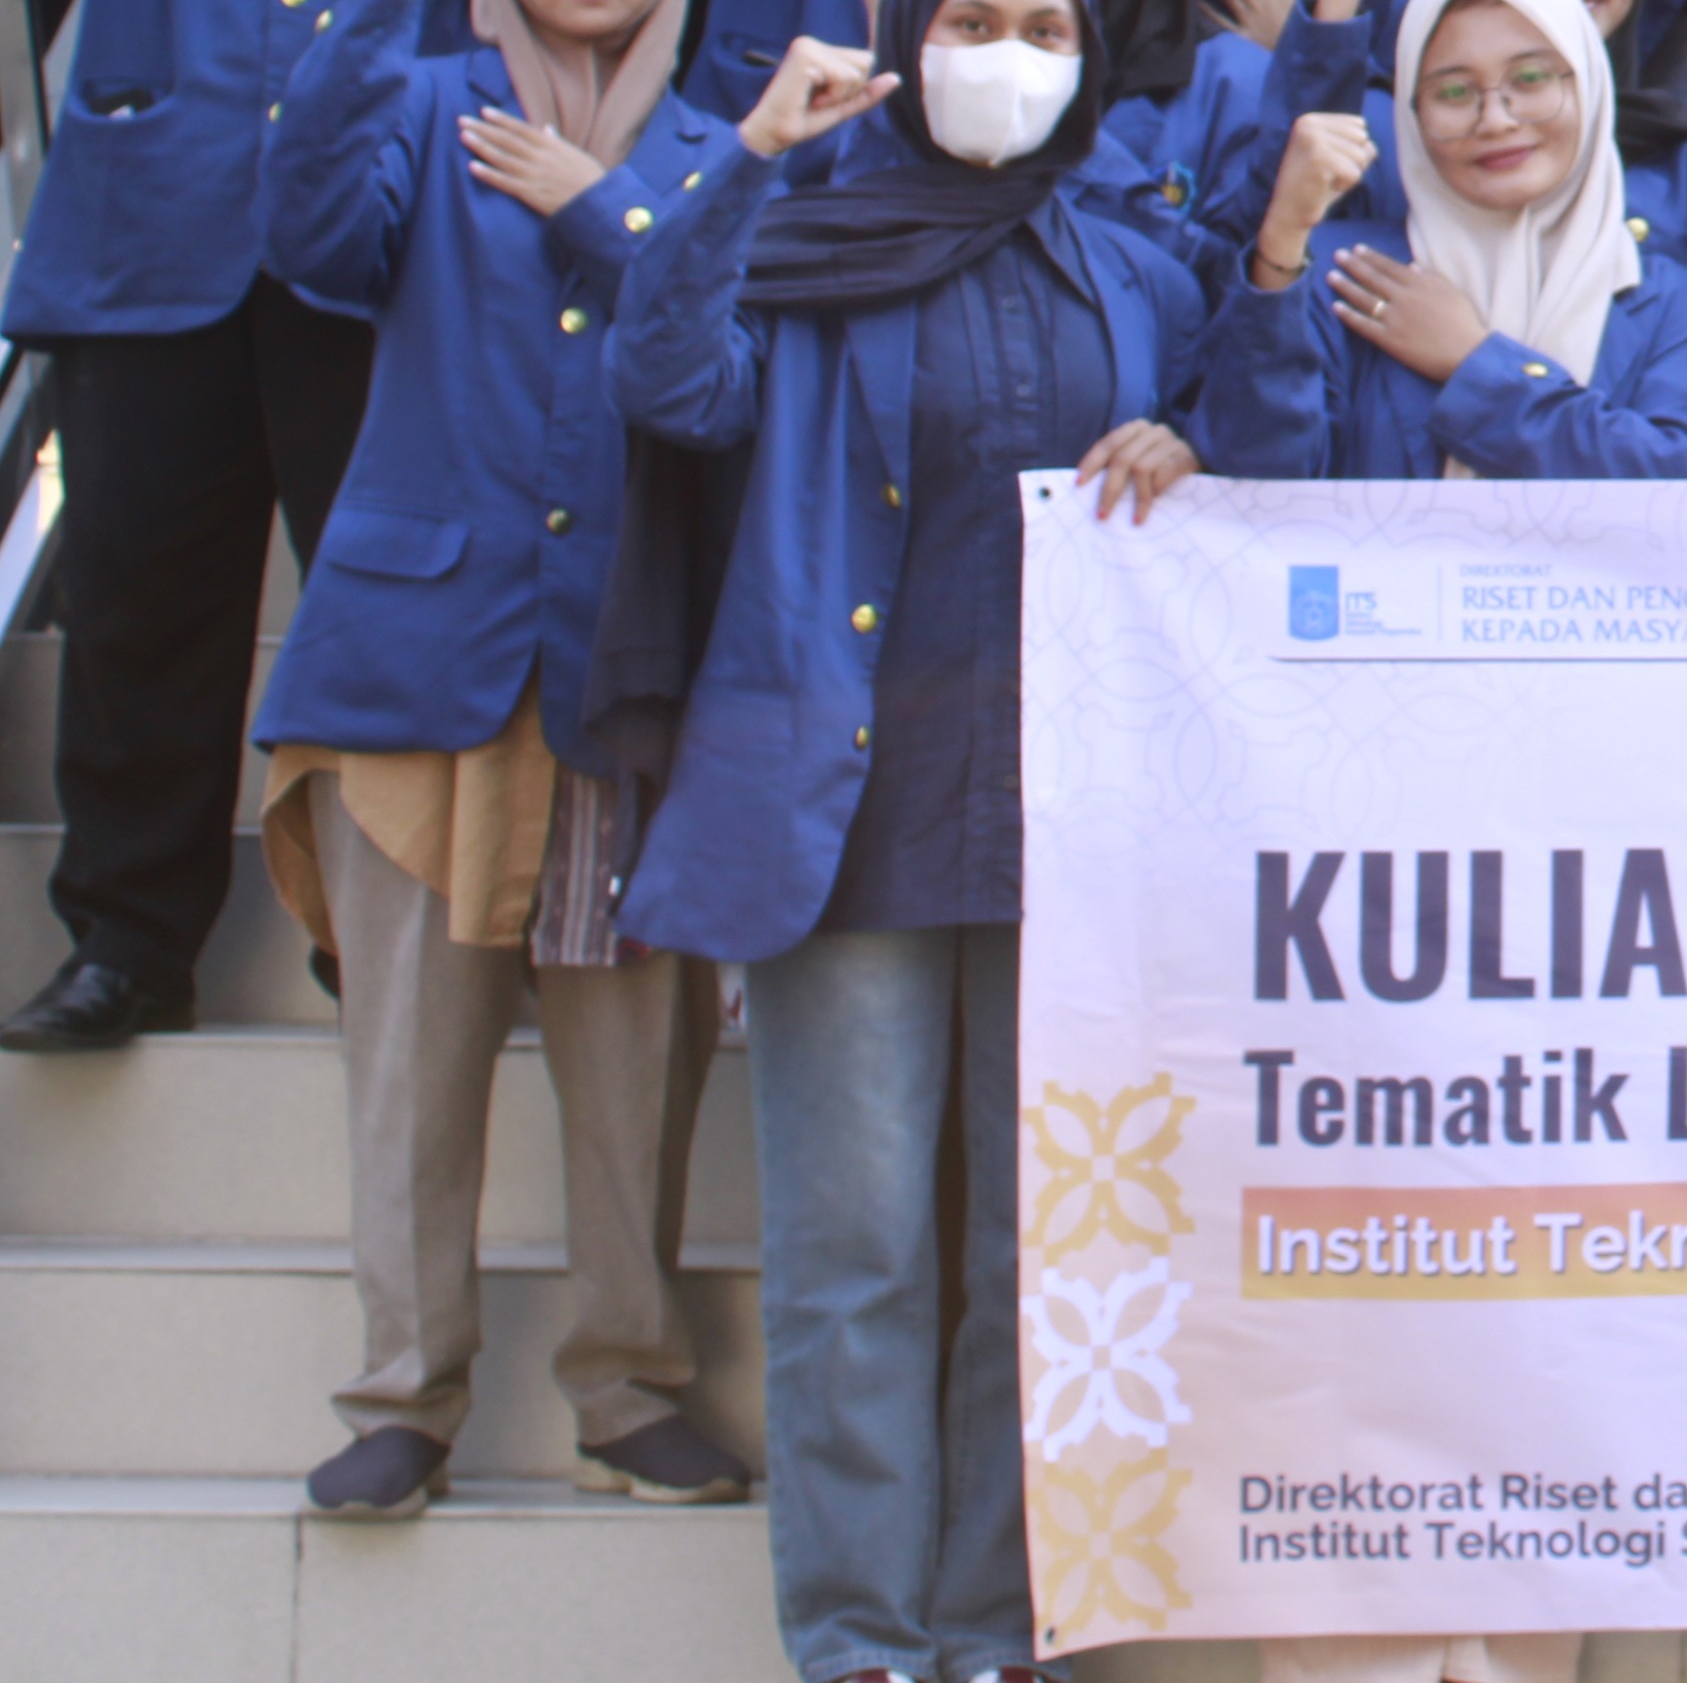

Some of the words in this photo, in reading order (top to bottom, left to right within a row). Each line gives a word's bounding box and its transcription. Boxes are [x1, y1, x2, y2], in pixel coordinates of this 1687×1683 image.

[1345, 591, 1377, 611] ITS
[1461, 585, 1538, 611] RISET
[1547, 585, 1616, 610] DAN
[1462, 618, 1584, 642] KEPADA
[1241, 1047, 1629, 1149] Tematik
[1256, 1213, 1515, 1275] Institut
[1239, 1473, 1484, 1515] Direktorat
[1499, 1473, 1619, 1513] Riset
[1239, 1521, 1411, 1563] Institut
[1425, 1518, 1666, 1570] Teknologi
